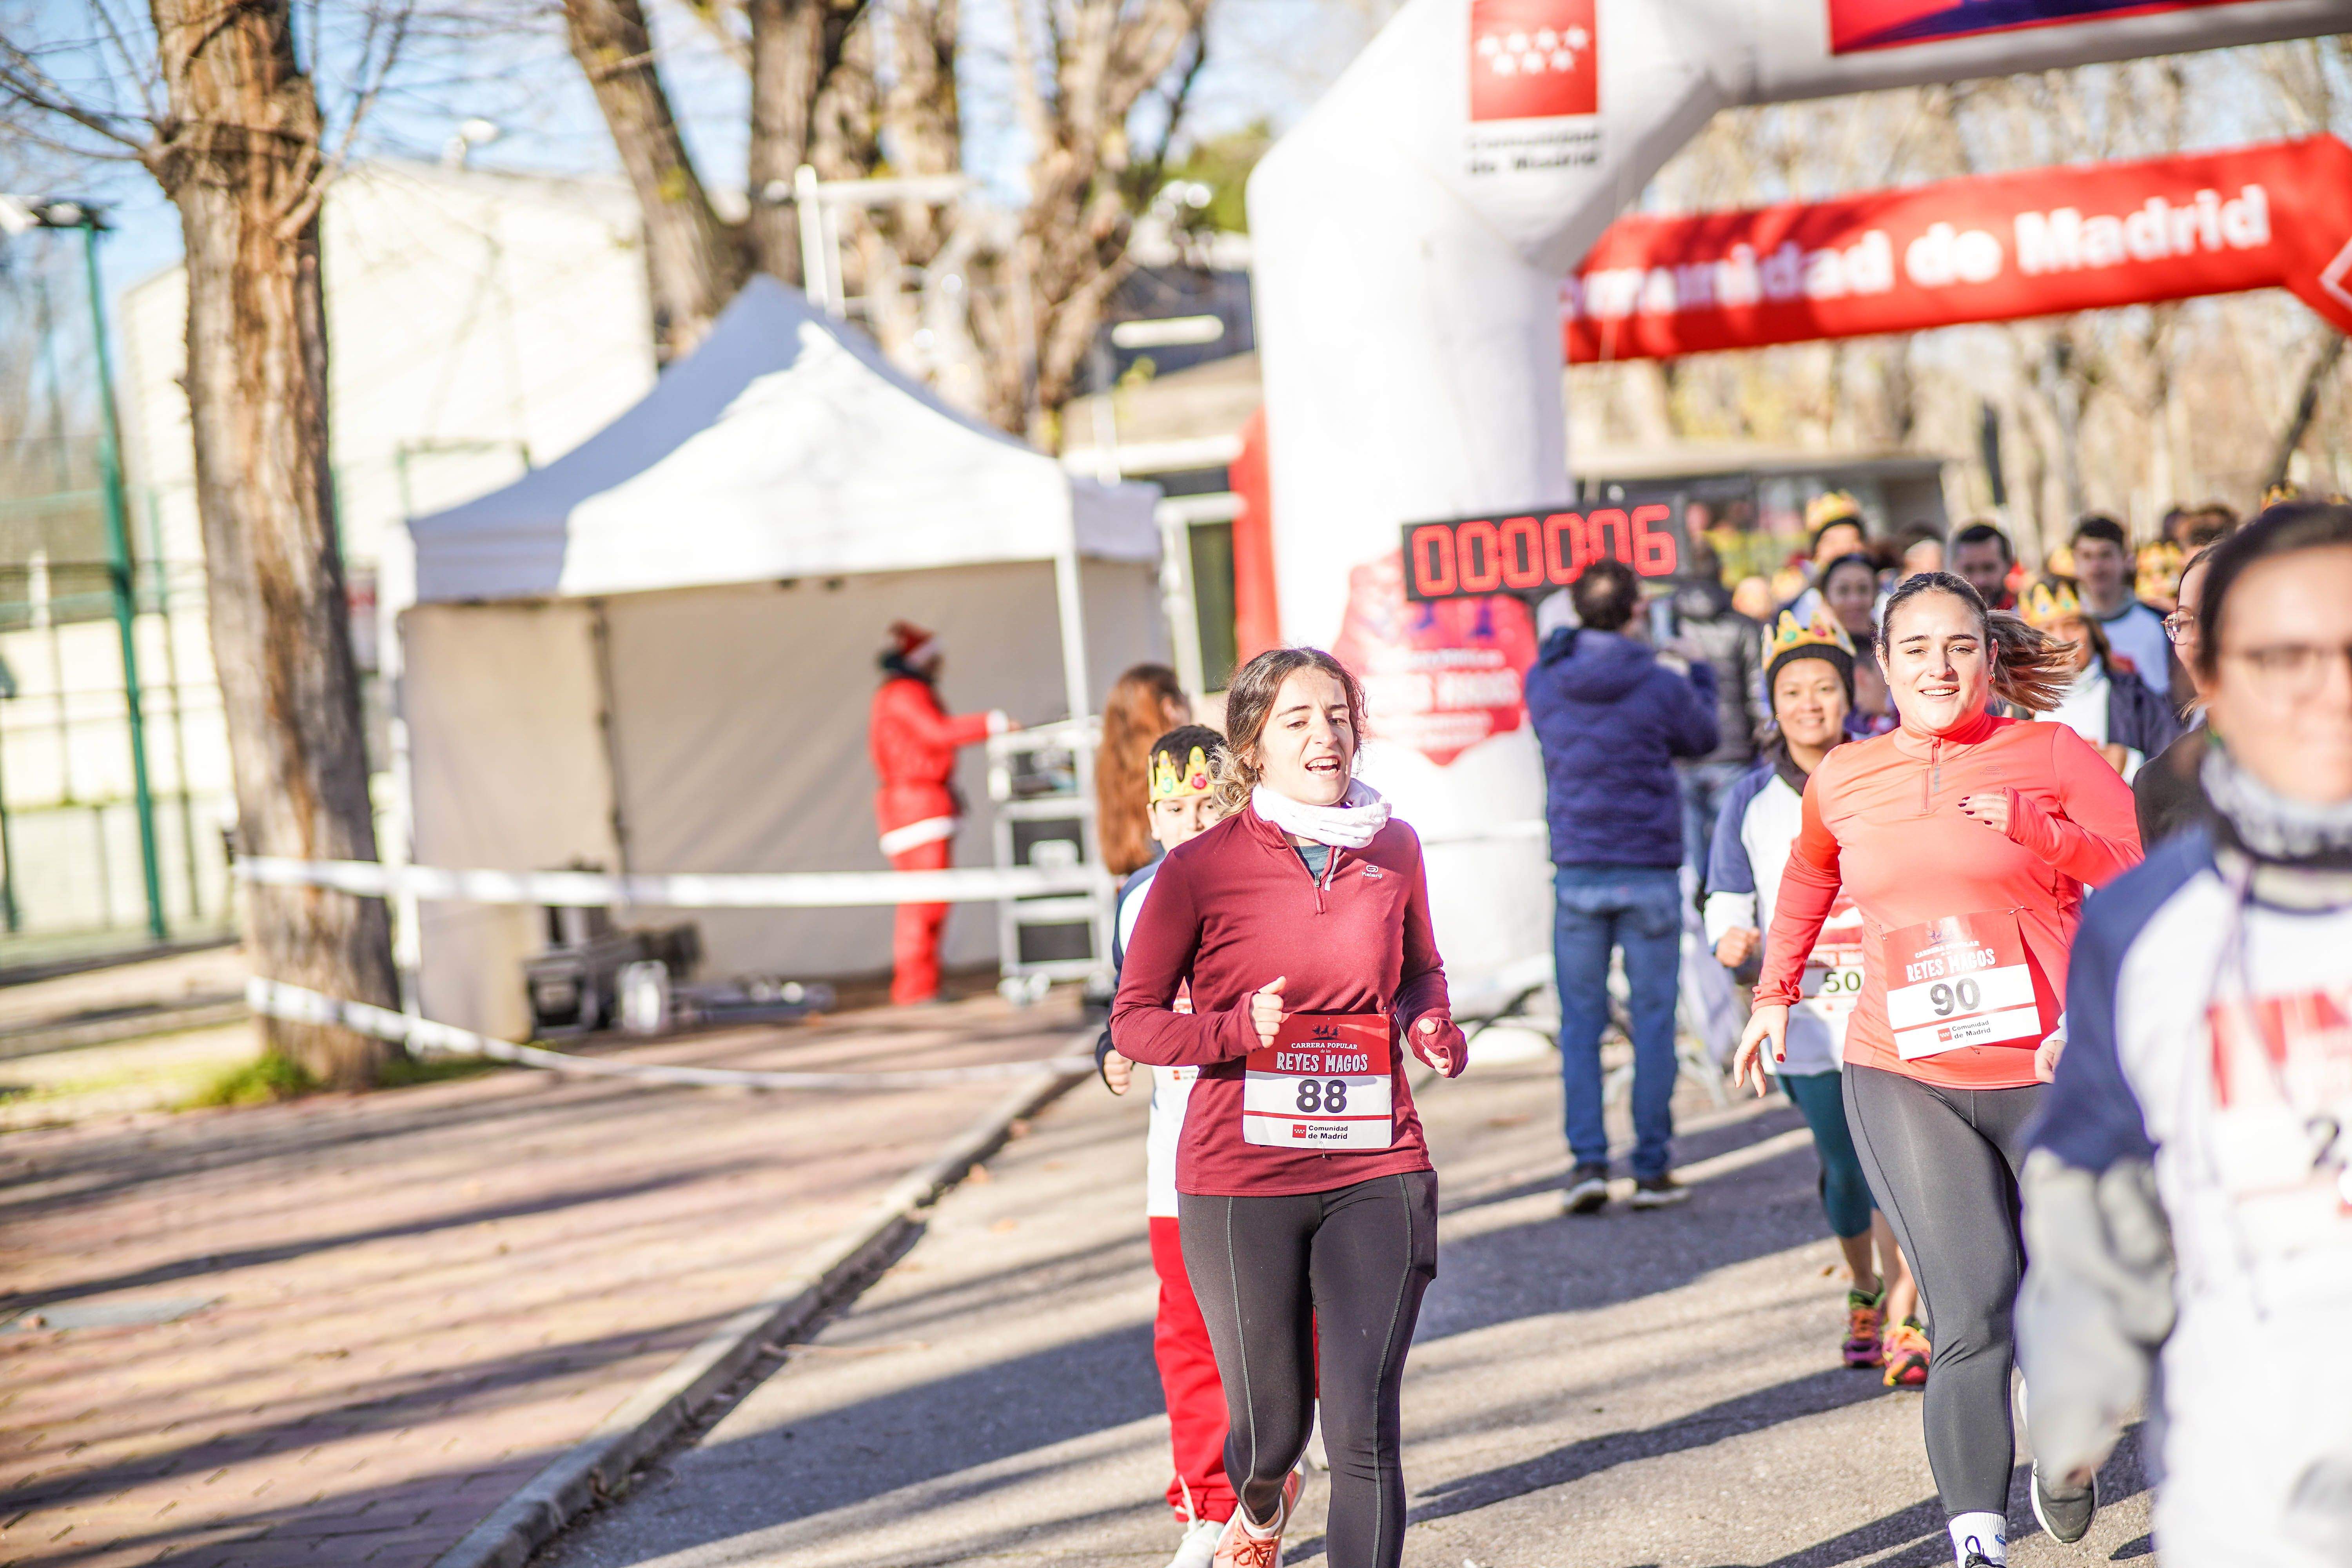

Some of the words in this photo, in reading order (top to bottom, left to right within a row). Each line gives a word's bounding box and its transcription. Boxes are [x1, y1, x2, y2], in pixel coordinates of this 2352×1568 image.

[1906, 221, 2002, 288] de
[2015, 184, 2270, 276] Madrid
[1906, 958, 1944, 982] REYES
[1947, 948, 1996, 974] MAGOS
[1930, 978, 1981, 1016] 90
[1952, 1020, 1989, 1031] Comunidad
[1966, 1027, 1991, 1036] Madrid
[1276, 1052, 1319, 1072] REYES
[1325, 1054, 1368, 1073] MAGOS
[1296, 1080, 1347, 1113] 88
